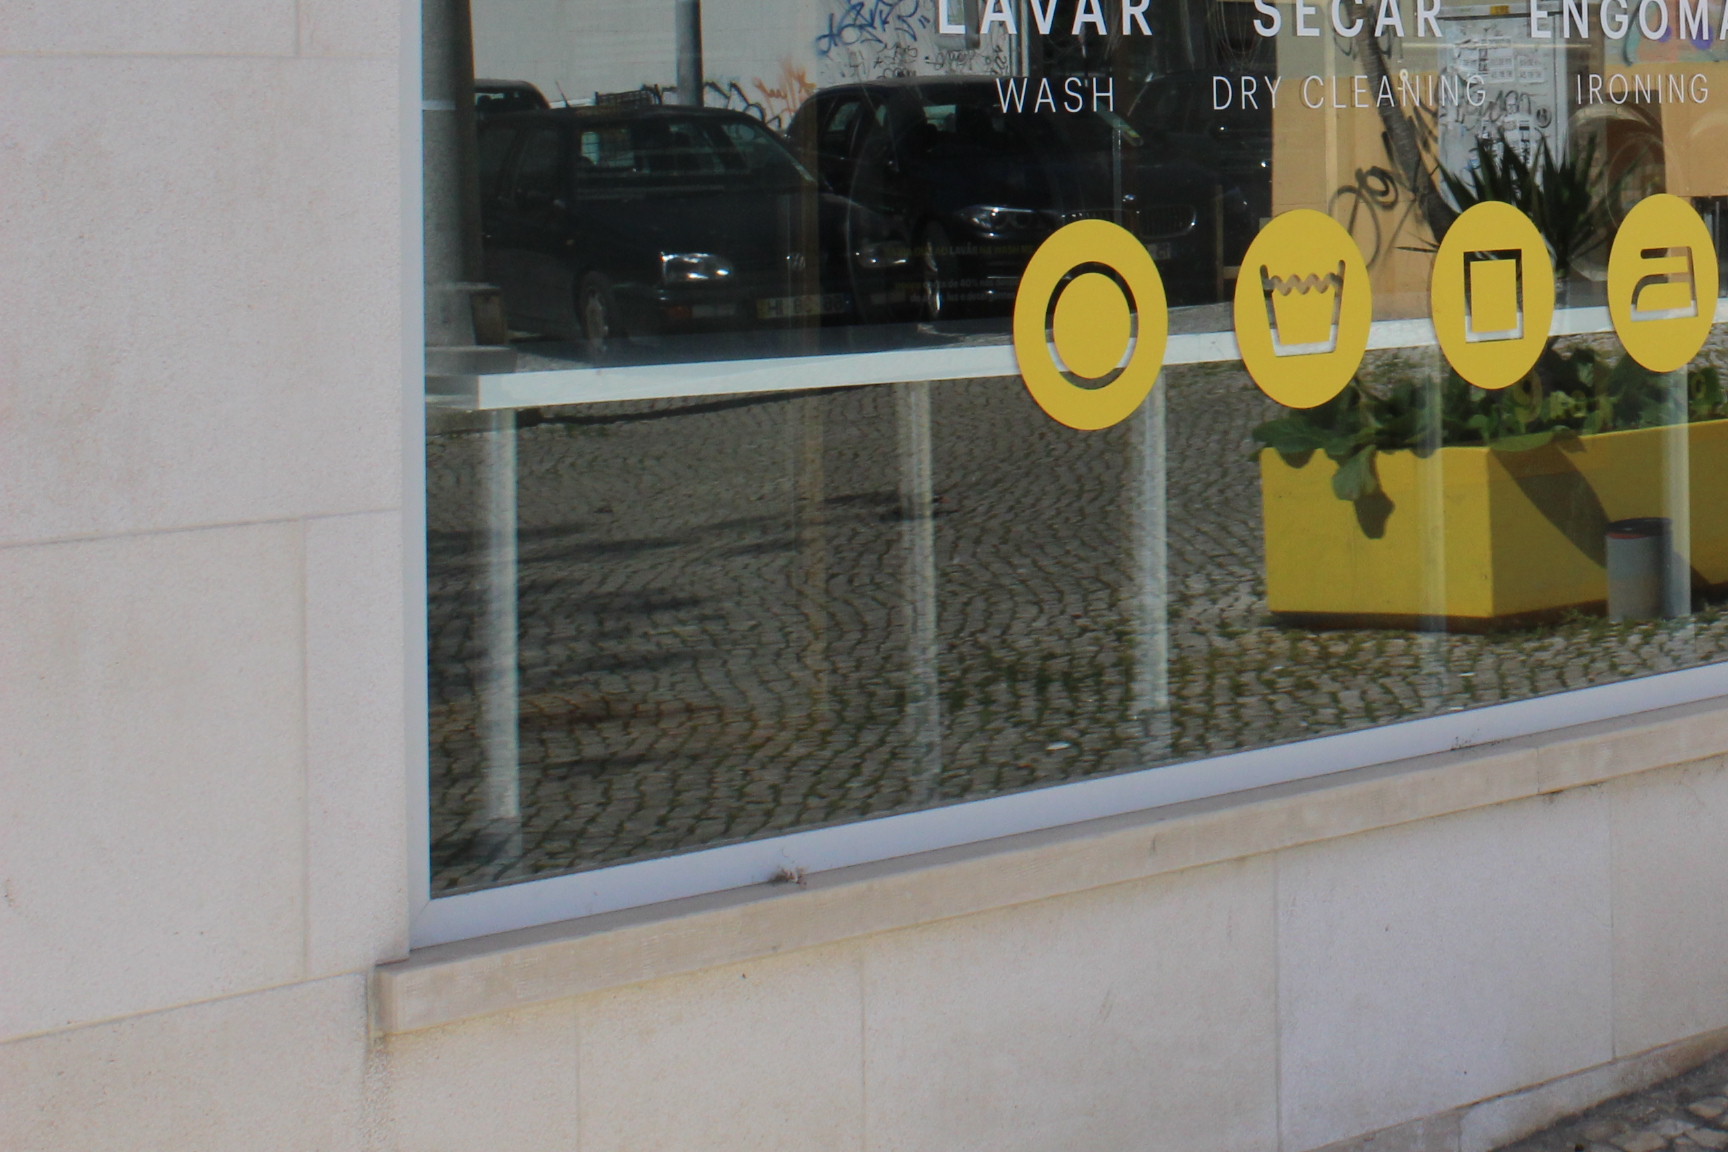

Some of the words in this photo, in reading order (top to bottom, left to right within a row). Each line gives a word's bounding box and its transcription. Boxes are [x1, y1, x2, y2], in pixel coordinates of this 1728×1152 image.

[996, 76, 1116, 113] WASH
[1211, 75, 1282, 111] DRY
[1301, 73, 1488, 110] CLEANING
[1576, 73, 1711, 106] IRONING
